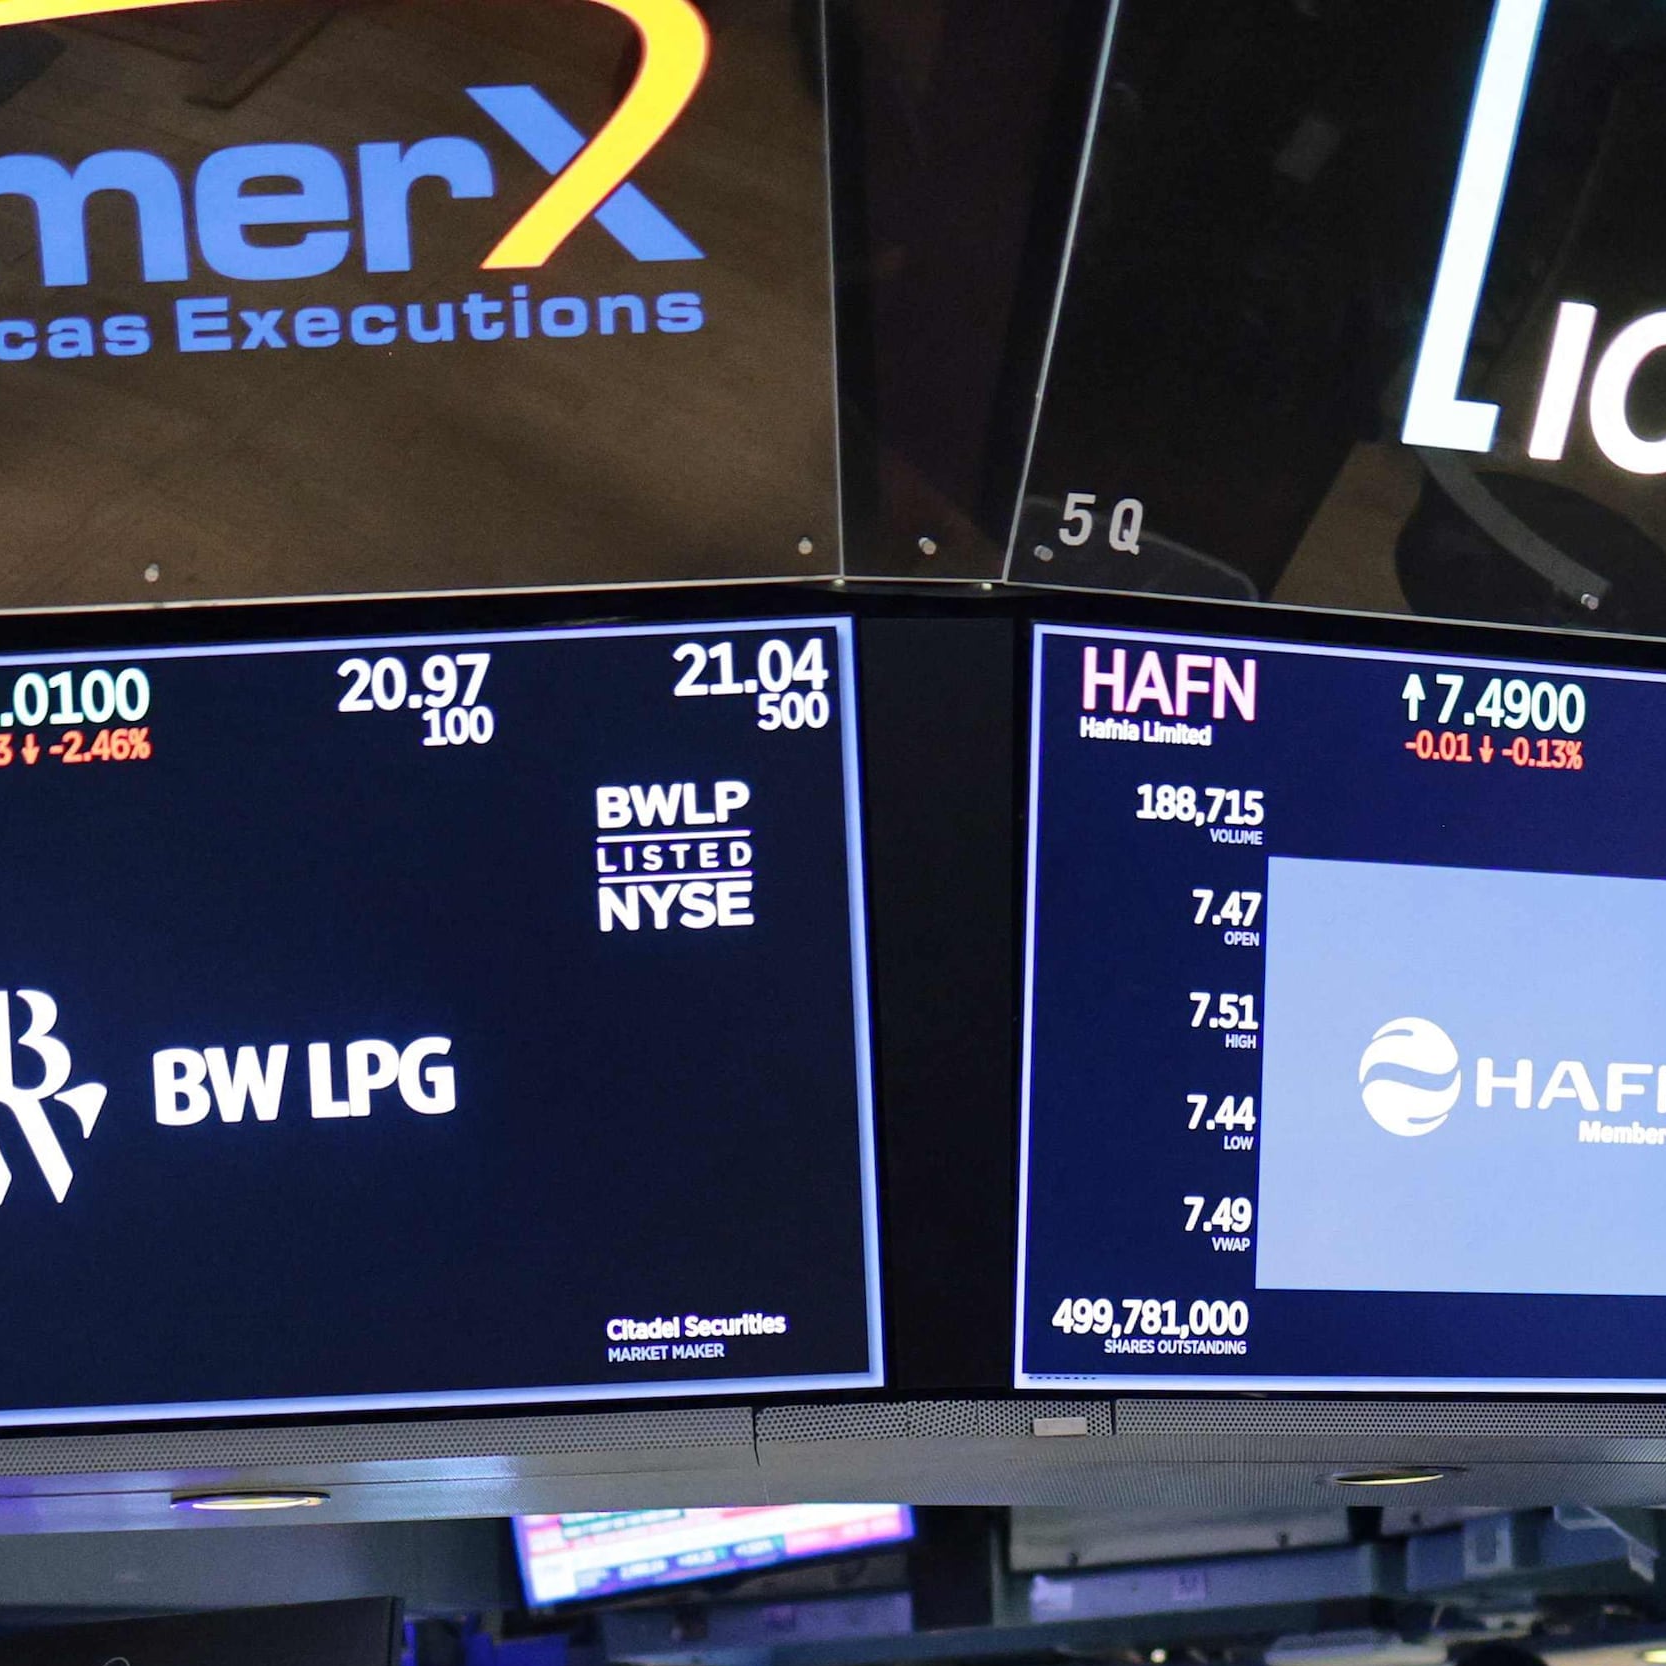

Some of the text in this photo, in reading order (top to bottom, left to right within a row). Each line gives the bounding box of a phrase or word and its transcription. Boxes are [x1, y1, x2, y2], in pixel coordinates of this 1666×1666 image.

[177, 288, 704, 354] Executions
[337, 654, 491, 712] 20.97
[673, 639, 828, 696] 21.04
[1082, 646, 1256, 721] HAFN
[757, 691, 829, 730] 500
[1435, 674, 1586, 733] 7.4900
[49, 728, 151, 762] -2.46%
[422, 706, 494, 746] 100
[1080, 717, 1212, 746] Hafnia Limited
[1405, 730, 1583, 770] -0.01 -0.13%
[596, 781, 750, 829] BWLP
[1136, 784, 1264, 827] 188,715
[1210, 828, 1263, 844] VOLUME
[597, 841, 752, 873] LISTED
[598, 880, 754, 931] NYSE
[1192, 890, 1261, 926] 7.47
[1224, 931, 1259, 947] OPEN
[1189, 993, 1259, 1031] 7.51
[1225, 1033, 1257, 1050] HIGH
[152, 1036, 456, 1127] BW LPG
[1186, 1095, 1256, 1133] 7.44
[1223, 1135, 1254, 1151] LOW
[1183, 1197, 1252, 1234] 7.49
[1211, 1237, 1250, 1253] VWAP
[607, 1313, 786, 1341] Citadel Securities
[1052, 1299, 1249, 1339] 499,781,000
[608, 1343, 724, 1362] MARKET MAKER
[1103, 1339, 1247, 1356] SHARES OUTSTANDING
